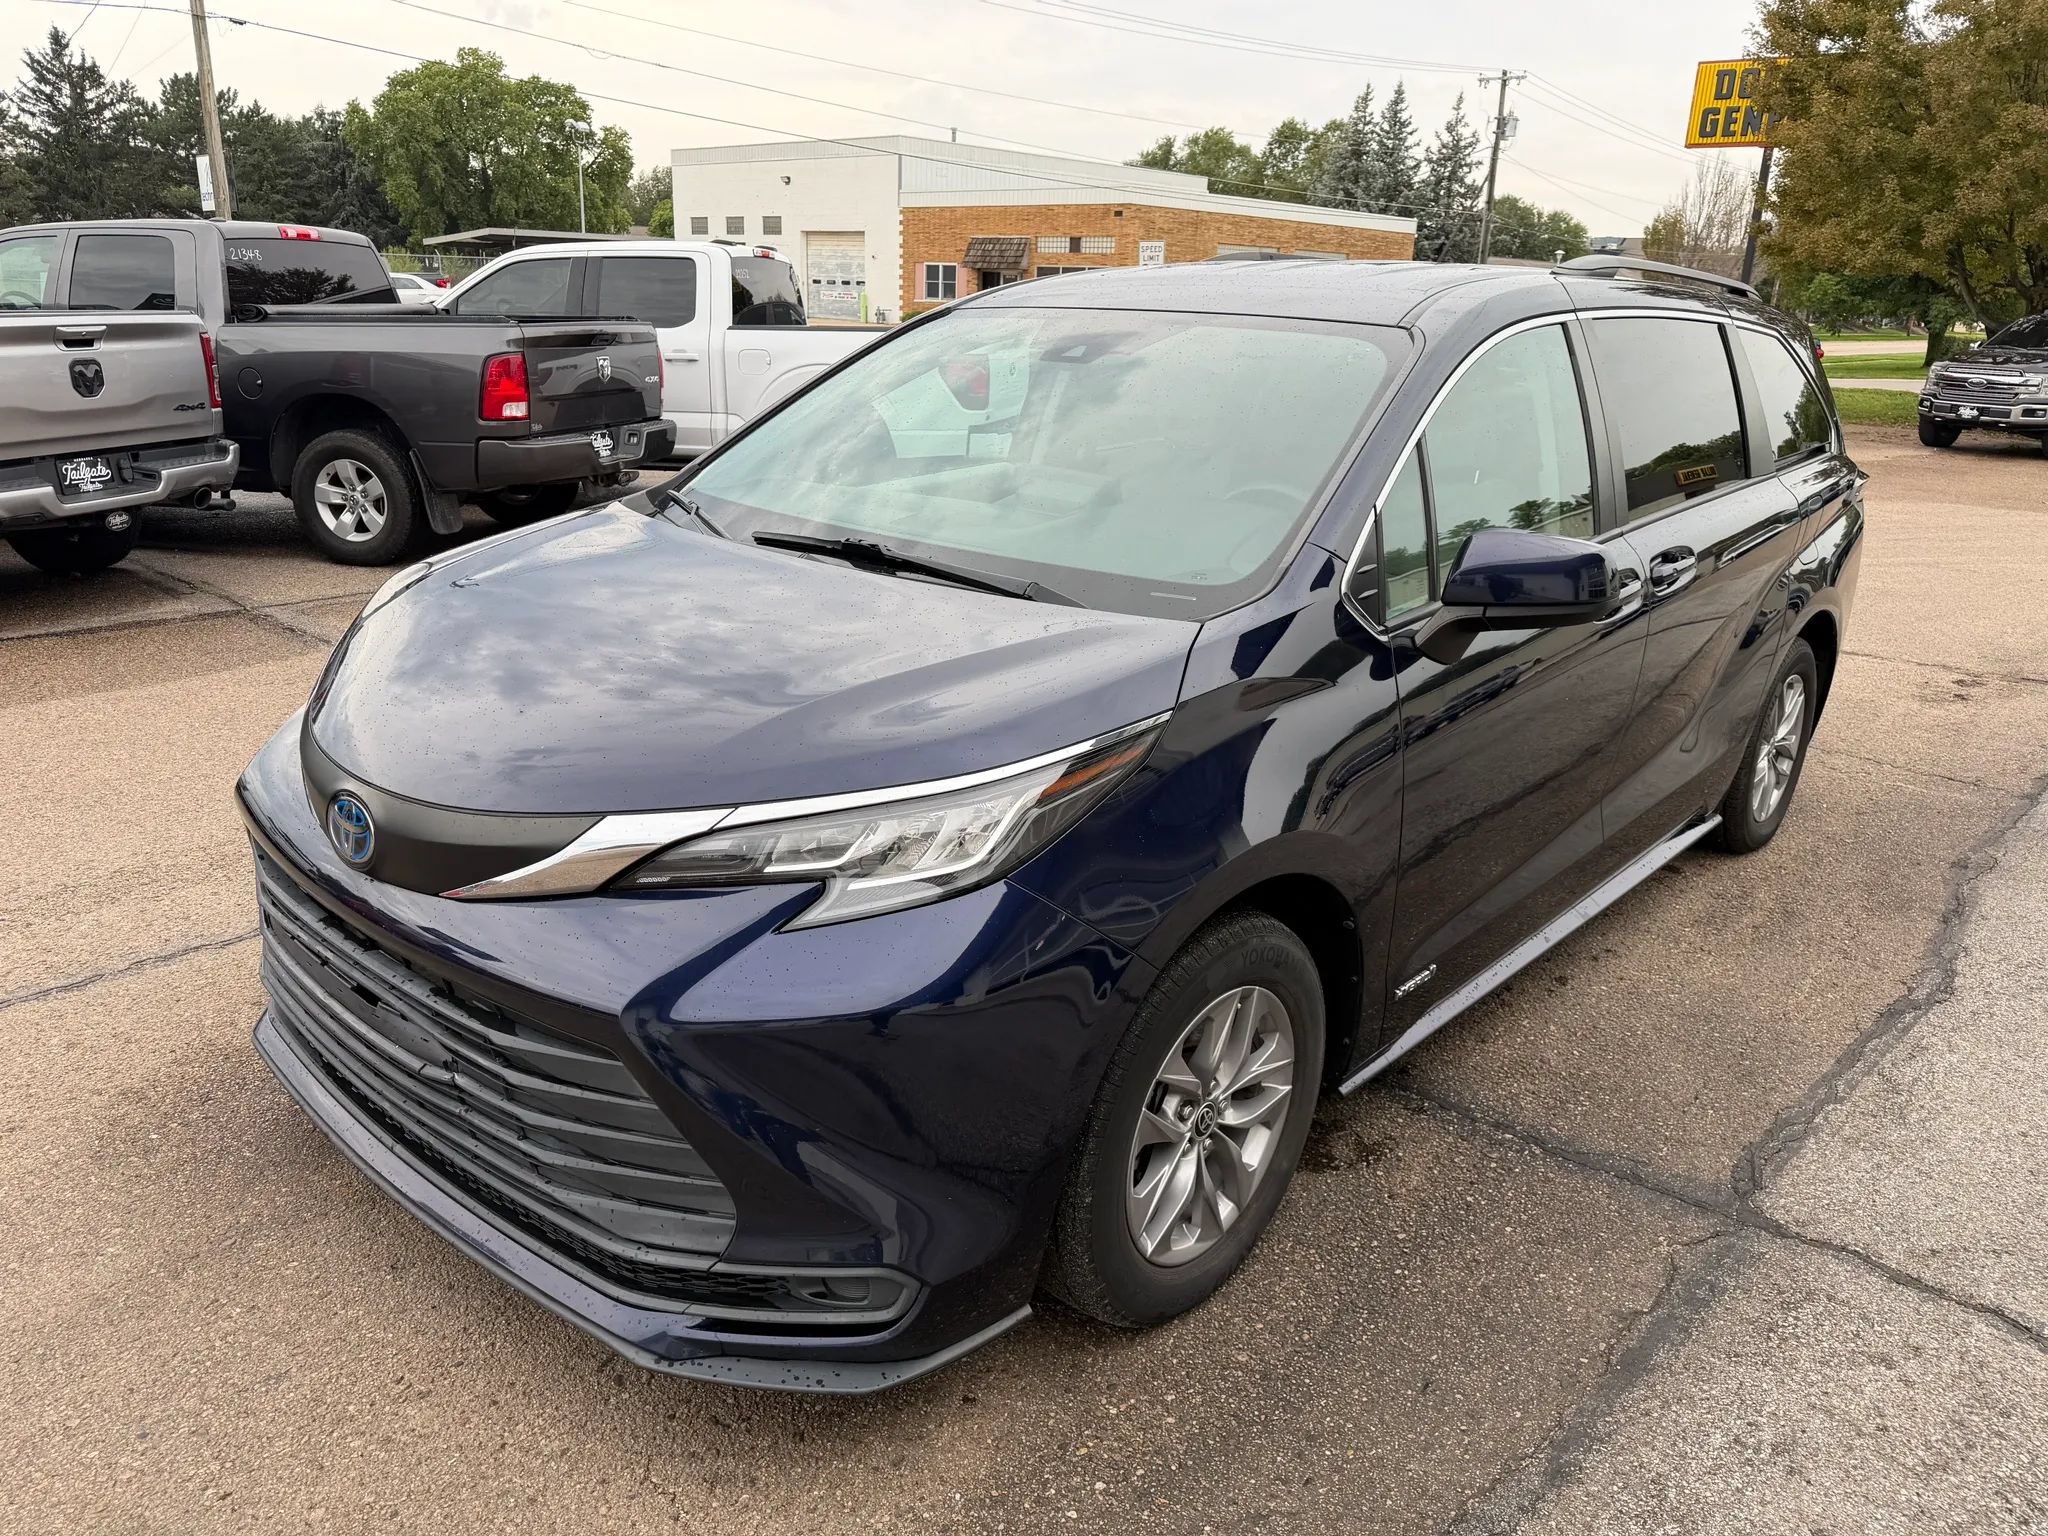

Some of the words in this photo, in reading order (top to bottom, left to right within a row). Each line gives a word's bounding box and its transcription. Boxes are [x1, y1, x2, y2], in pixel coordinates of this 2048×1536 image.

[1714, 68, 1761, 100] DO
[229, 247, 263, 261] 21348
[1141, 245, 1162, 253] SPEED
[1143, 254, 1160, 262] LIMIT
[62, 458, 112, 486] Tailgate
